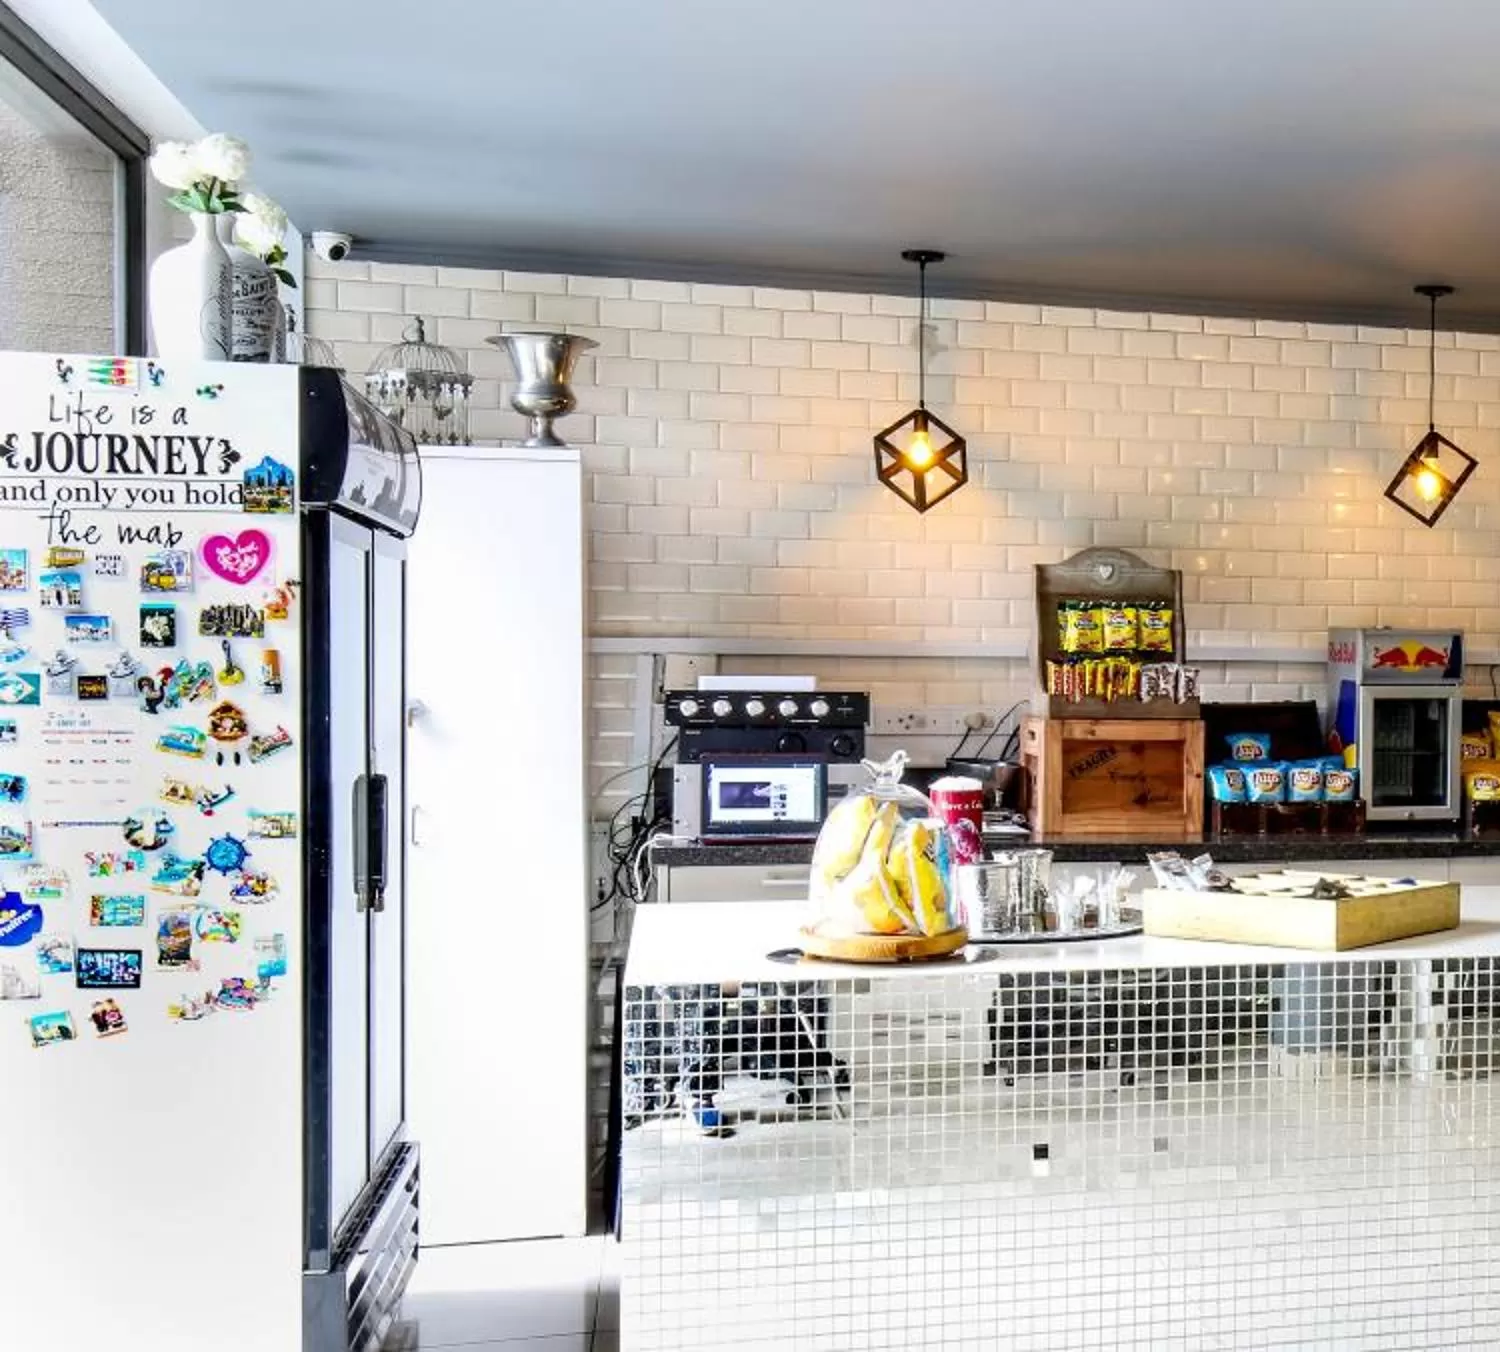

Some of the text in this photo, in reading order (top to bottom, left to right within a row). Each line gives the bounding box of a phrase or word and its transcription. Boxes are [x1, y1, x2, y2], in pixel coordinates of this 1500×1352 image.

[49, 389, 188, 437] Life is a
[25, 431, 215, 475] JOURNEY
[0, 479, 246, 509] and only you hold
[38, 500, 183, 548] the map
